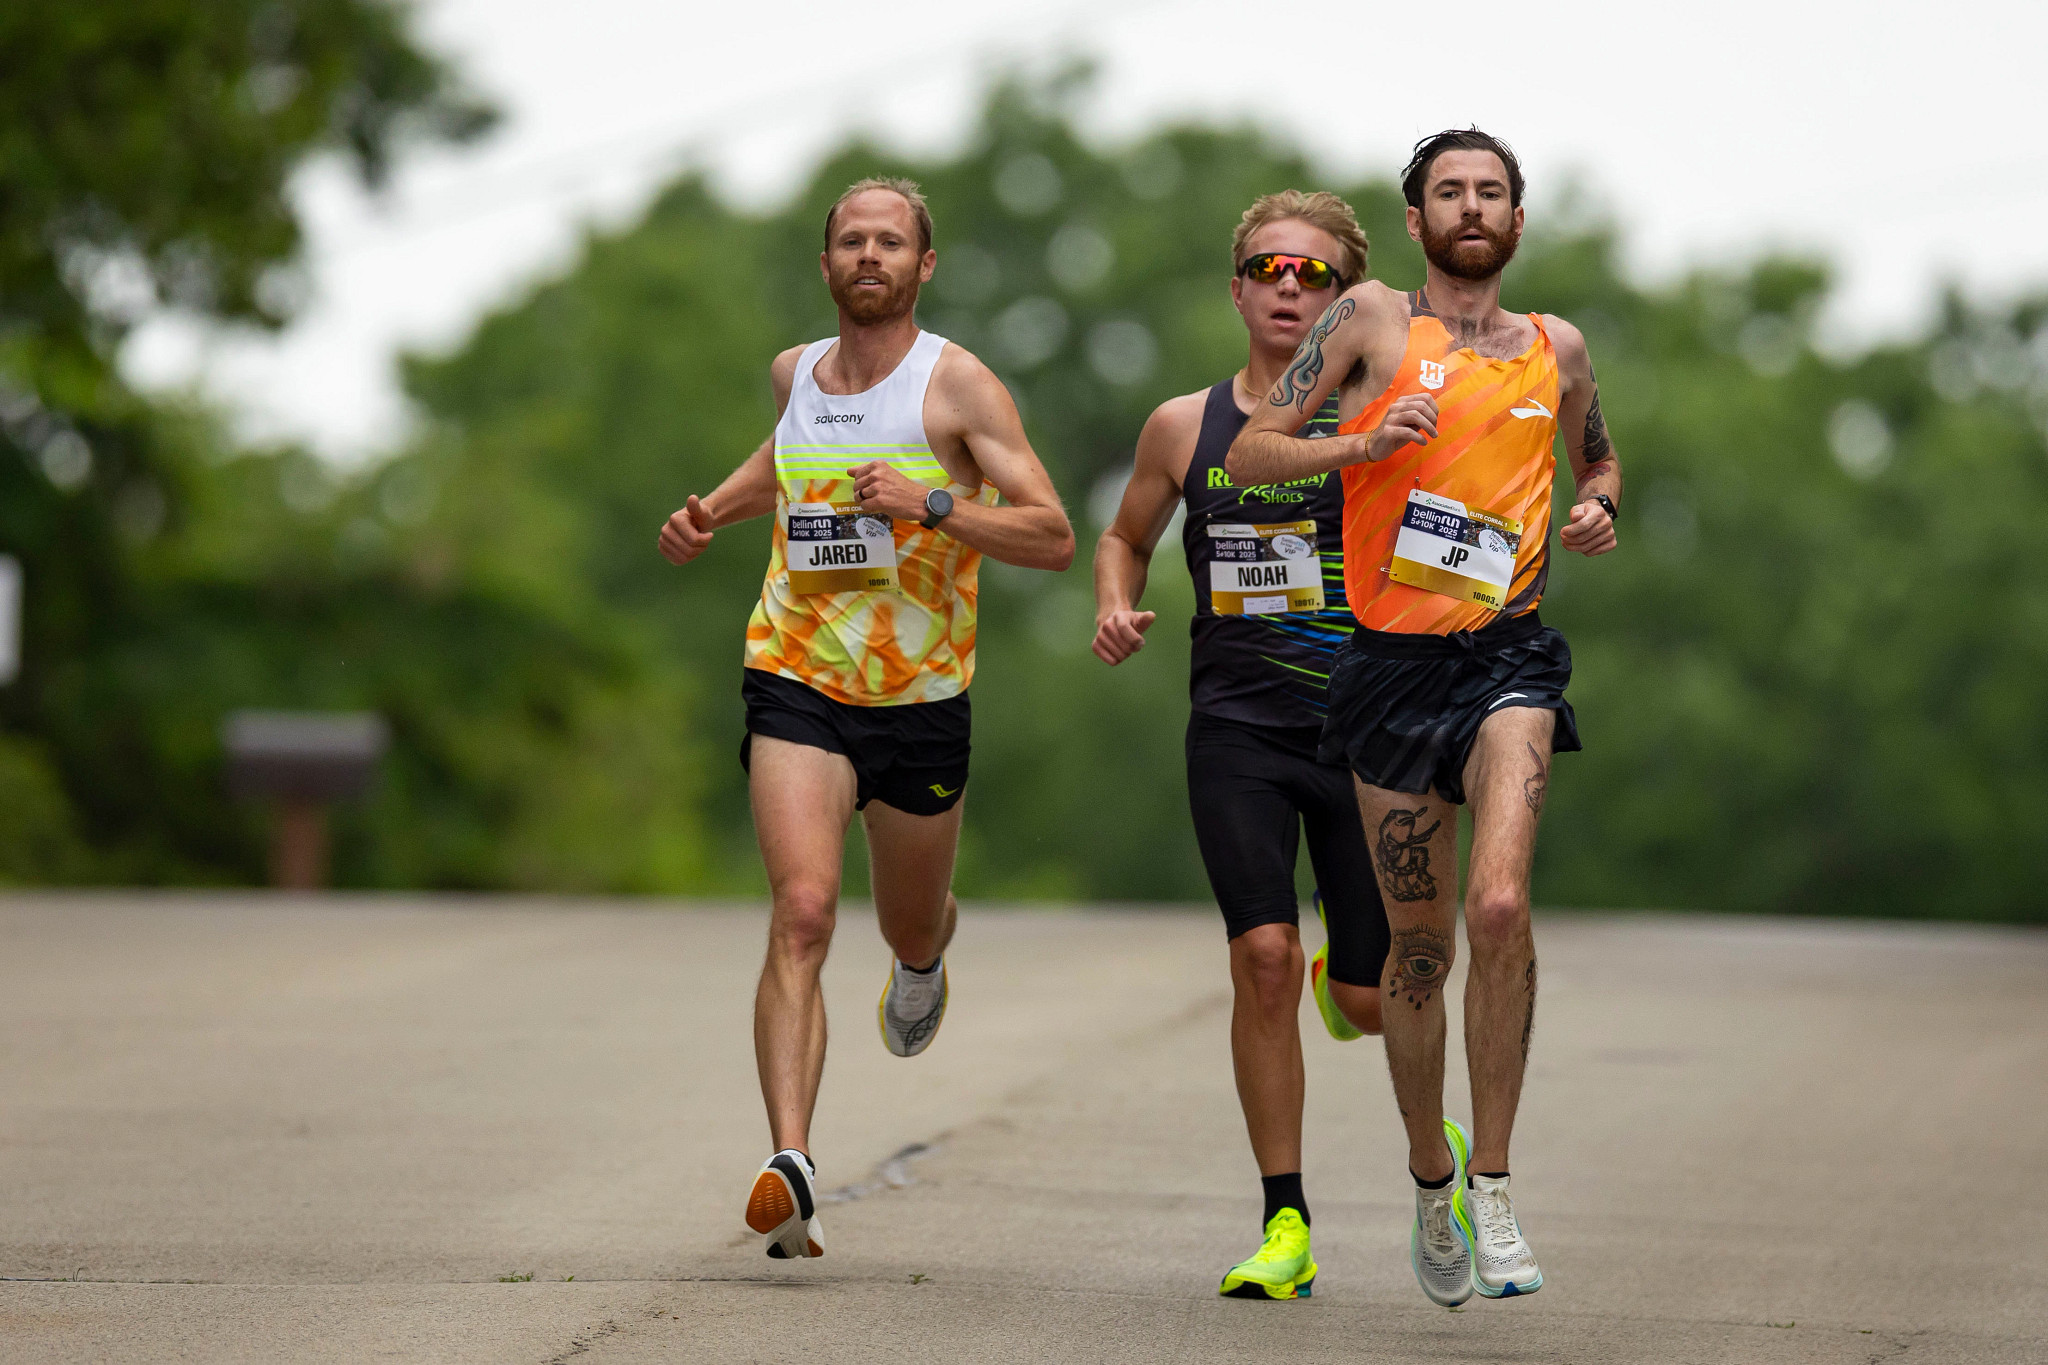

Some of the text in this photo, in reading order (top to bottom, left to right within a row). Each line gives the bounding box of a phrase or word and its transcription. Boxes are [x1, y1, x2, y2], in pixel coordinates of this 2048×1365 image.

[814, 414, 865, 425] saucony
[792, 518, 832, 529] bellinrun
[1412, 507, 1461, 529] bellinrun
[1469, 511, 1484, 520] ELITE
[1483, 515, 1504, 527] CORRAL
[814, 529, 832, 537] 2025
[865, 528, 877, 538] VIP
[1438, 525, 1458, 537] 2025
[1215, 540, 1255, 550] bellinrun
[1284, 546, 1297, 555] VIP
[1488, 541, 1499, 553] VIP
[809, 543, 868, 567] JARED
[1441, 545, 1469, 568] JP
[1237, 565, 1288, 587] NOAH
[868, 578, 890, 587] 10001
[1472, 591, 1496, 605] 10003
